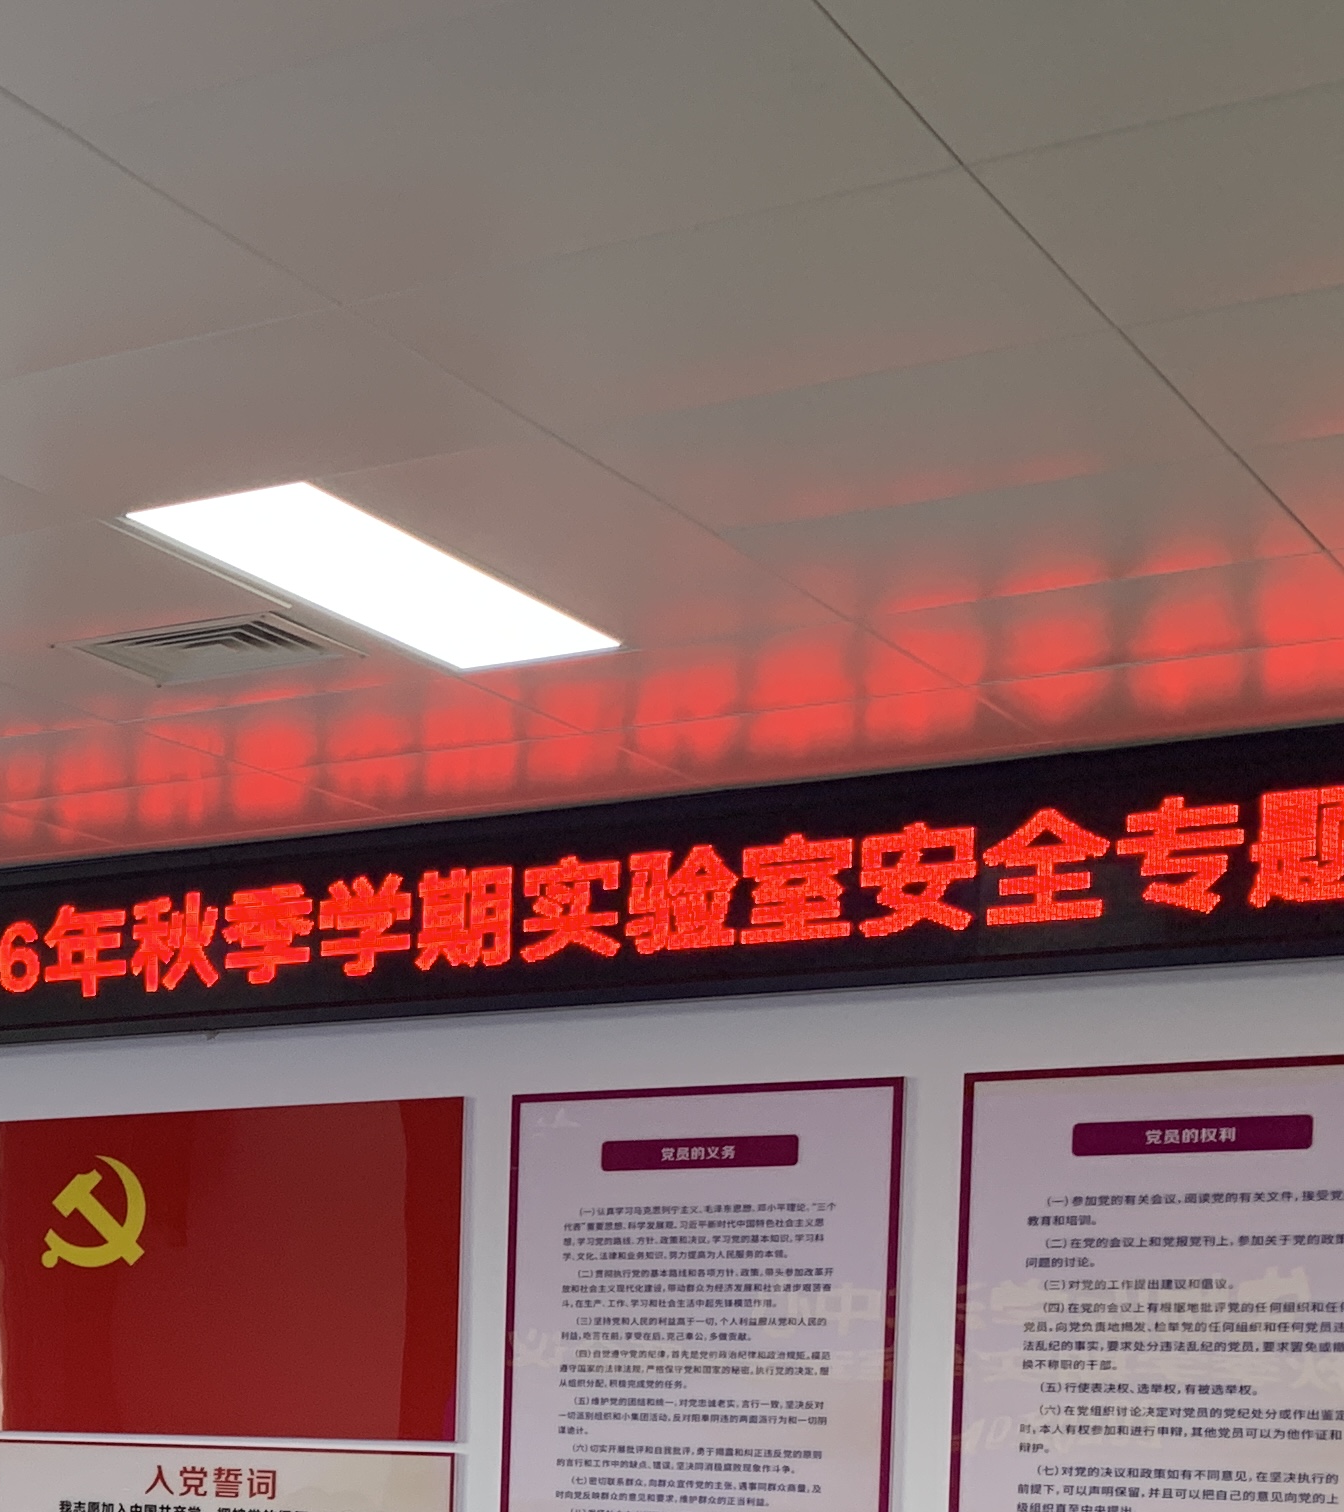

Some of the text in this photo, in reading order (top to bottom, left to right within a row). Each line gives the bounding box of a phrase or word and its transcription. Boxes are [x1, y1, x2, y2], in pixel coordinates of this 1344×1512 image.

[1144, 1126, 1237, 1146] 党员的权利
[660, 1145, 736, 1162] 党员的义务
[1028, 1215, 1096, 1226] 教育和培训。
[1026, 1257, 1094, 1268] 问题的讨论。
[1019, 1442, 1048, 1453] 辩护。
[145, 1464, 277, 1500] 入党誓词
